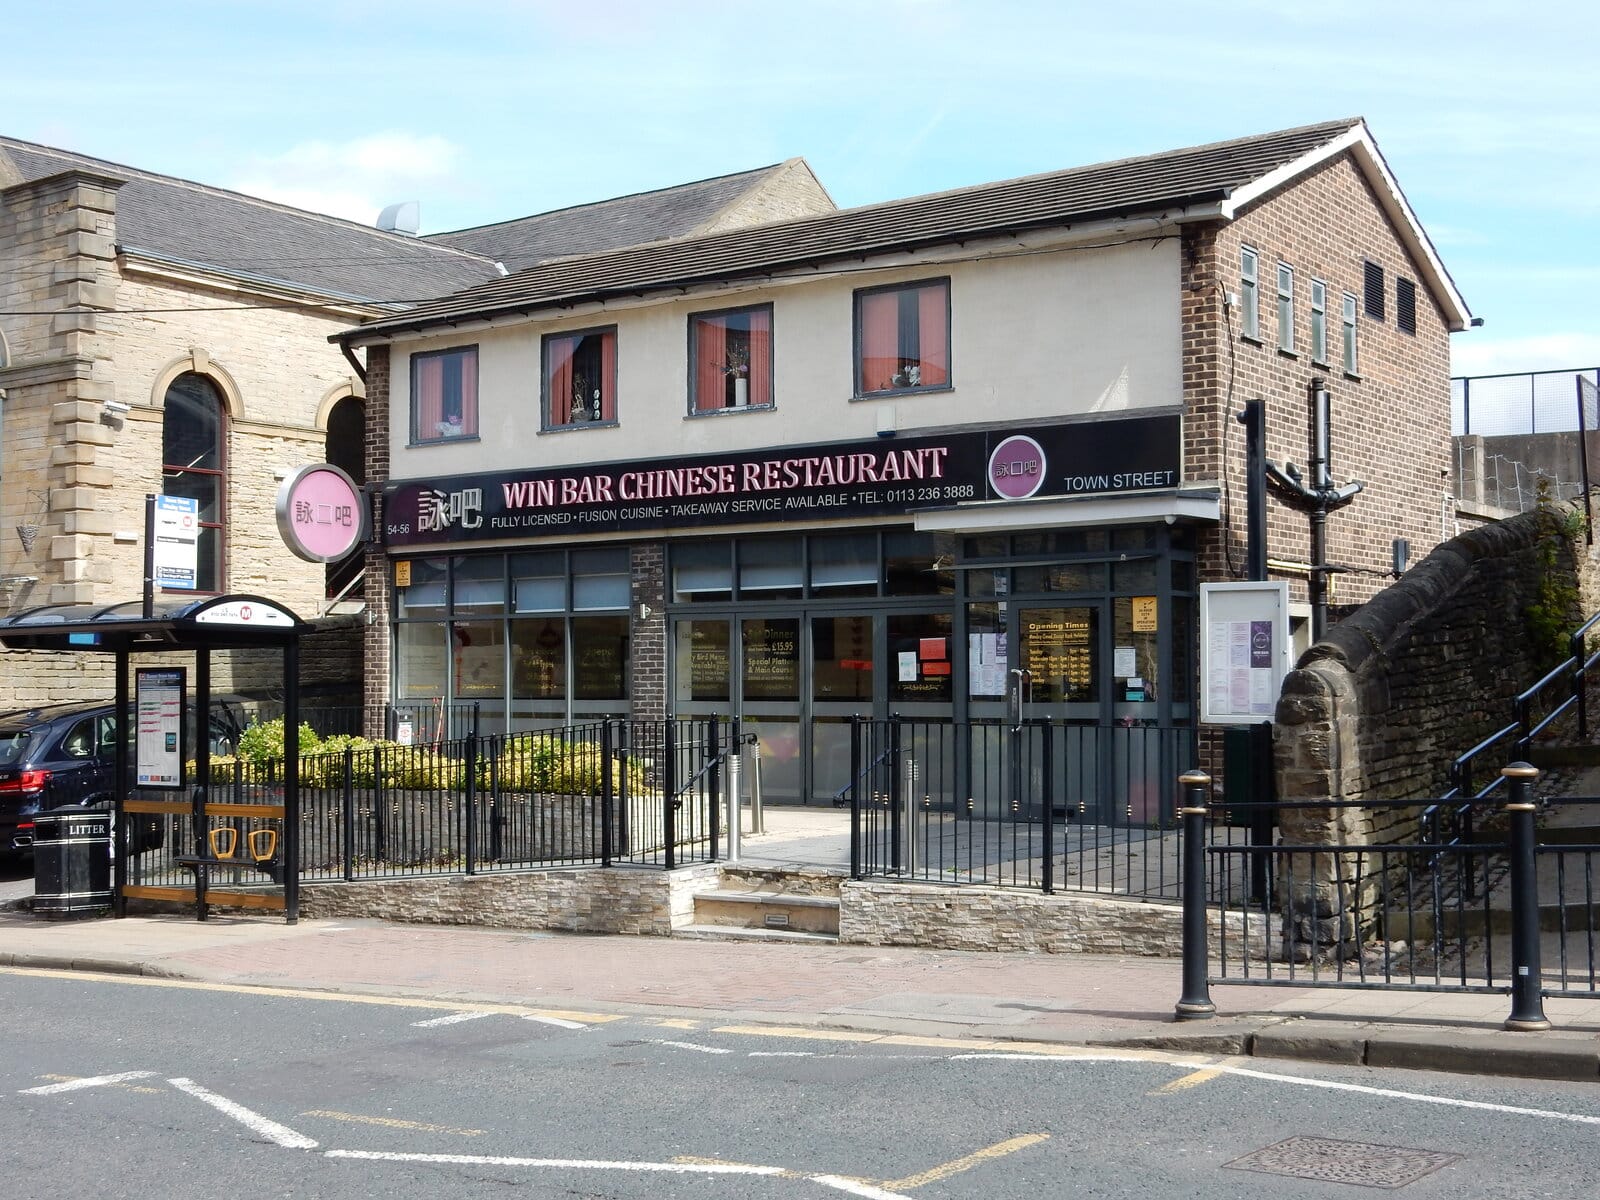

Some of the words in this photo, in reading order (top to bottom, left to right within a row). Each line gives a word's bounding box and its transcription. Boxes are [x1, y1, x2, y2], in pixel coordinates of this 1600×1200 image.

[502, 479, 555, 509] WIN
[560, 475, 614, 505] BAR
[619, 465, 735, 500] CHINESE
[741, 447, 948, 492] RESTAURANT
[1064, 475, 1109, 491] TOWN
[1113, 470, 1174, 488] STREET
[491, 515, 521, 529] FULLY
[522, 512, 571, 527] LICENSED
[579, 509, 617, 523] FUSION
[620, 506, 663, 520] CUISINE
[671, 501, 729, 517] TAKEAWAY
[731, 498, 781, 513] SERVICE
[785, 493, 848, 509] AVAILABLE
[858, 491, 884, 505] TEL:
[887, 488, 915, 503] 0113
[918, 486, 941, 501] 236
[943, 484, 974, 499] 3888
[387, 523, 410, 535] 54-56
[1029, 622, 1064, 630] Opening
[764, 628, 794, 640] Dinner
[772, 641, 794, 651] £15.95
[748, 658, 771, 667] Special
[69, 824, 105, 834] LITTER
